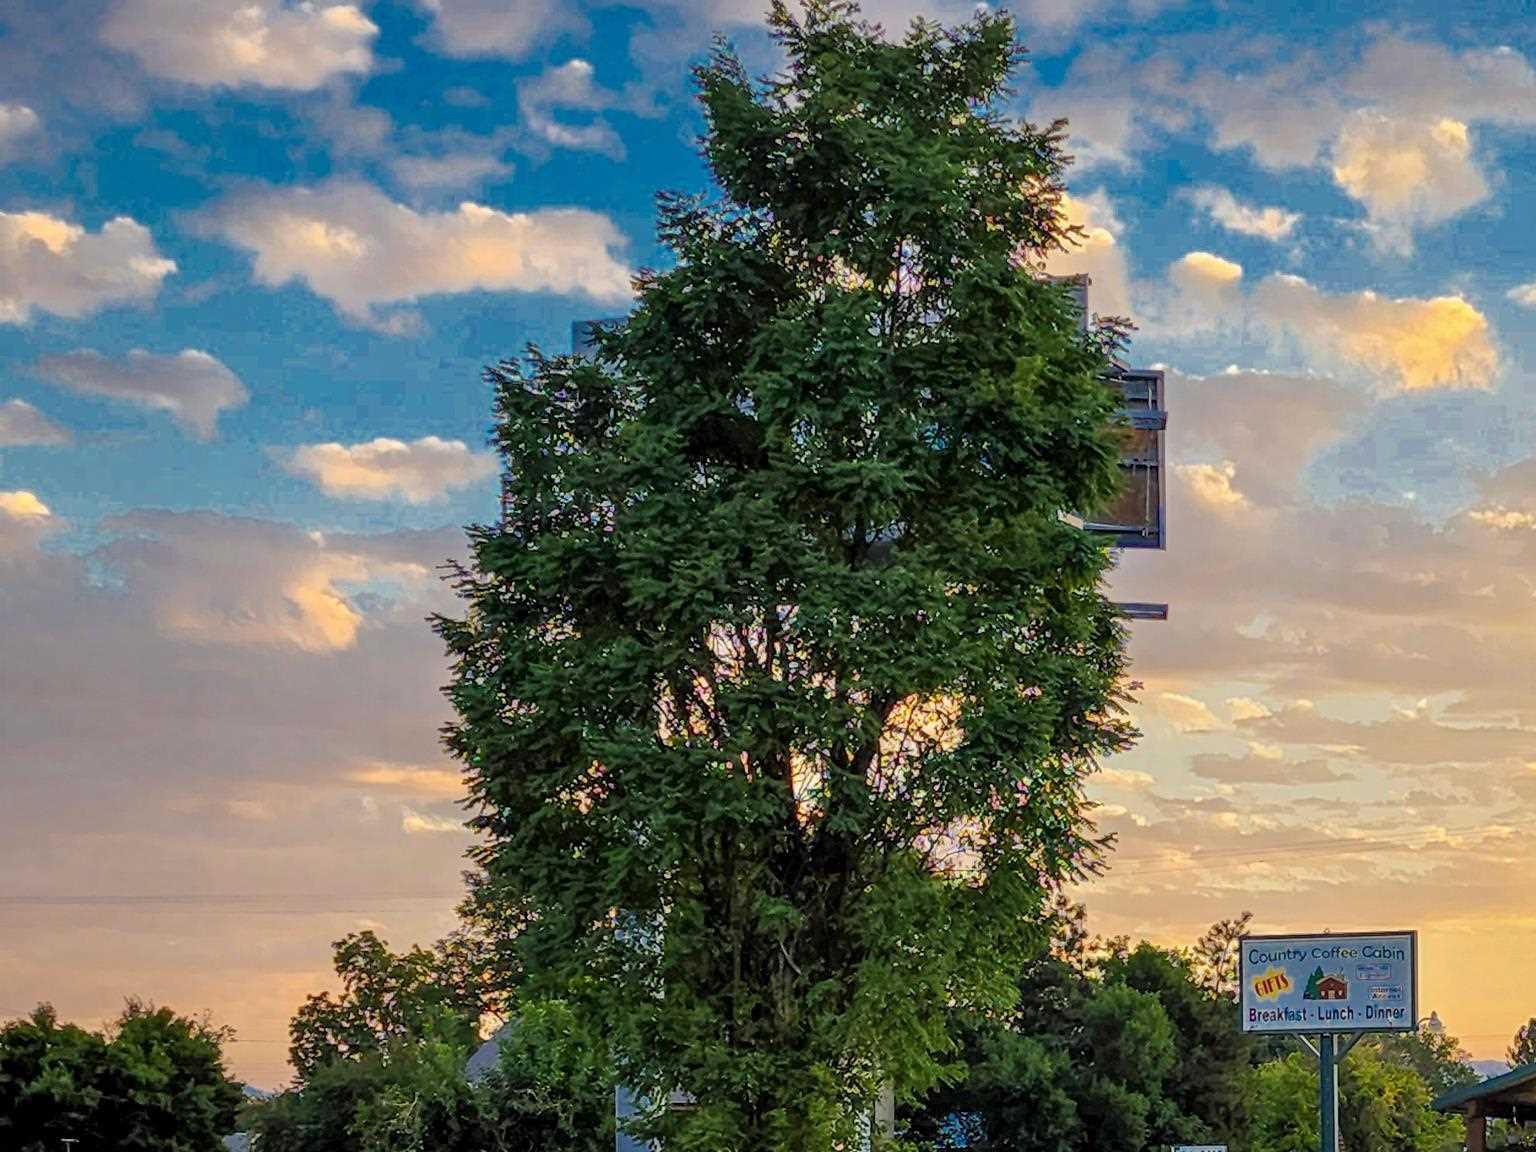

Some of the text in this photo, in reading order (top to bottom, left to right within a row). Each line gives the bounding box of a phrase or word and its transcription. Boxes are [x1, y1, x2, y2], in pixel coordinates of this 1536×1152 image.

[1248, 945, 1405, 965] Country Coffee Cabin
[1254, 973, 1289, 997] GIFTS
[1249, 1006, 1307, 1023] Breakfast
[1318, 1005, 1354, 1021] Lunch
[1365, 1004, 1405, 1020] Dinner
